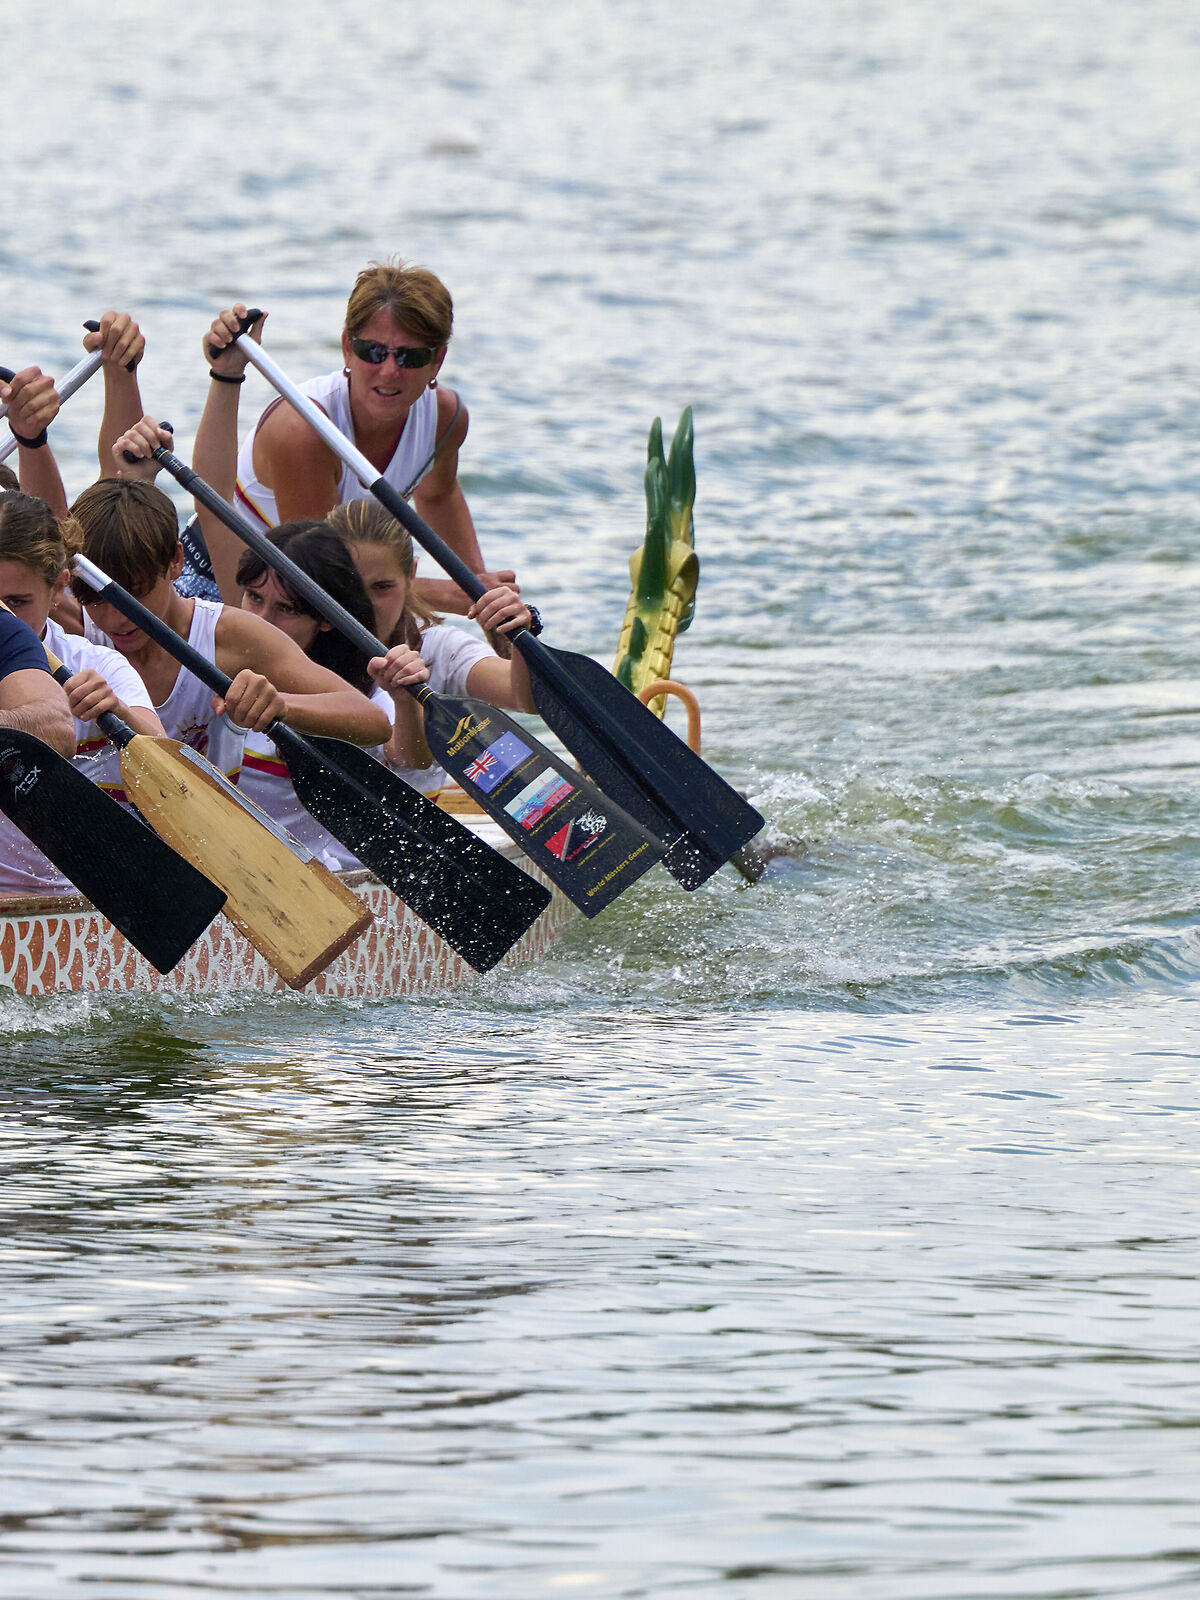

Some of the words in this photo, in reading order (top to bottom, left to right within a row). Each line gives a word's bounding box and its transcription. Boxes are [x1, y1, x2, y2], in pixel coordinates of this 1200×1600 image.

[446, 717, 492, 757] MotionMaster
[586, 879, 606, 897] World
[604, 859, 629, 882] Masters
[627, 842, 649, 861] Games
